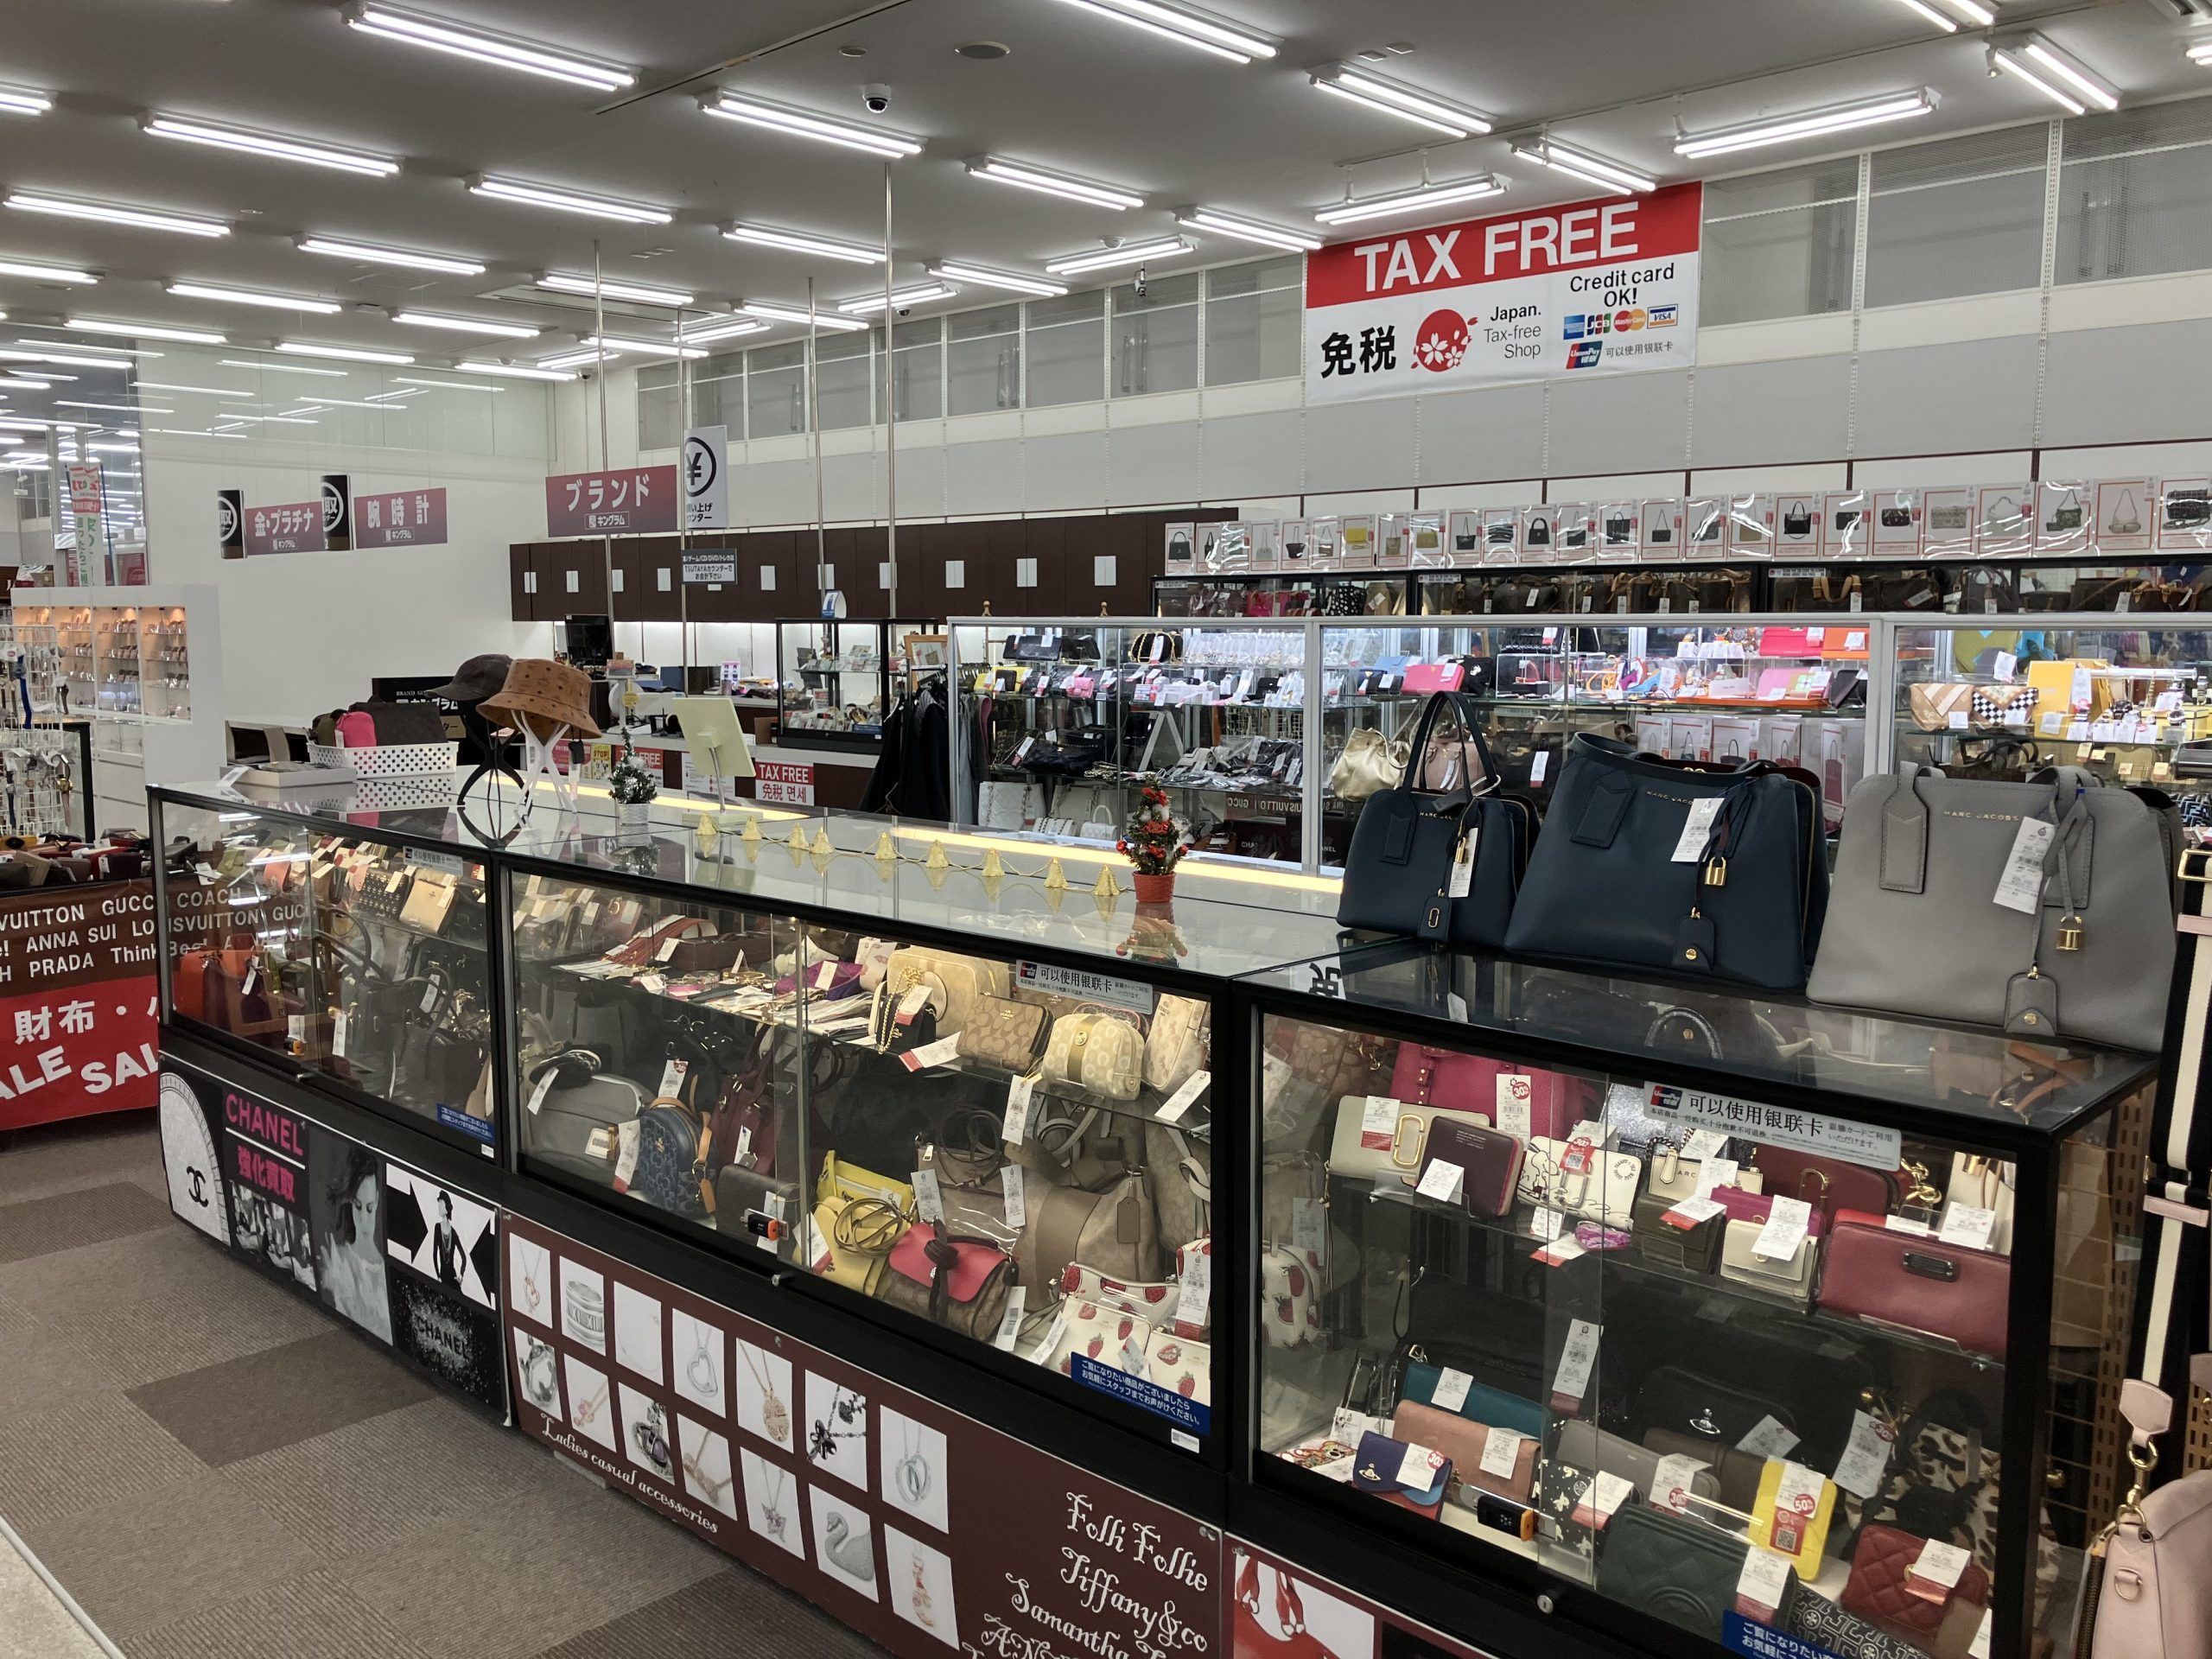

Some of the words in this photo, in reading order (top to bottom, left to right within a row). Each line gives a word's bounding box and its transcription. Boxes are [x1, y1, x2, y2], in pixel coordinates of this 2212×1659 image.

[1354, 230, 1461, 292] TAX
[1484, 201, 1638, 276] FREE
[1570, 268, 1628, 293] Credit
[1630, 263, 1675, 285] card
[1604, 288, 1638, 308] OK!
[1491, 305, 1541, 323] Japan.
[1654, 312, 1671, 321] VISA
[1484, 323, 1541, 343] Tax-free
[1320, 325, 1396, 378] 免税
[1504, 341, 1541, 360] Shop
[1605, 340, 1674, 359] 可以使用银联卡
[566, 474, 650, 512] ブランド
[366, 493, 429, 529] 腕時計
[597, 513, 626, 526] キングラム
[759, 764, 780, 780] TAX
[783, 766, 809, 784] FREE
[762, 783, 783, 800] 免税
[786, 785, 806, 804] 면세
[26, 931, 79, 953] ANNA
[87, 924, 117, 944] SUI
[131, 908, 259, 937] LOISVUITTON
[29, 952, 94, 978] PRADA
[1040, 967, 1113, 994] 可以使用银联卡
[80, 1042, 159, 1094] SAL
[226, 1093, 304, 1156] CHANEL
[1688, 1093, 1823, 1138] 可以使用银联卡
[1677, 1169, 1697, 1179] ARC
[541, 1413, 589, 1459] Ladies
[591, 1454, 638, 1485] casual
[638, 1479, 719, 1534] accessories
[1066, 1491, 1125, 1553] Folli
[1133, 1522, 1208, 1592] Follie
